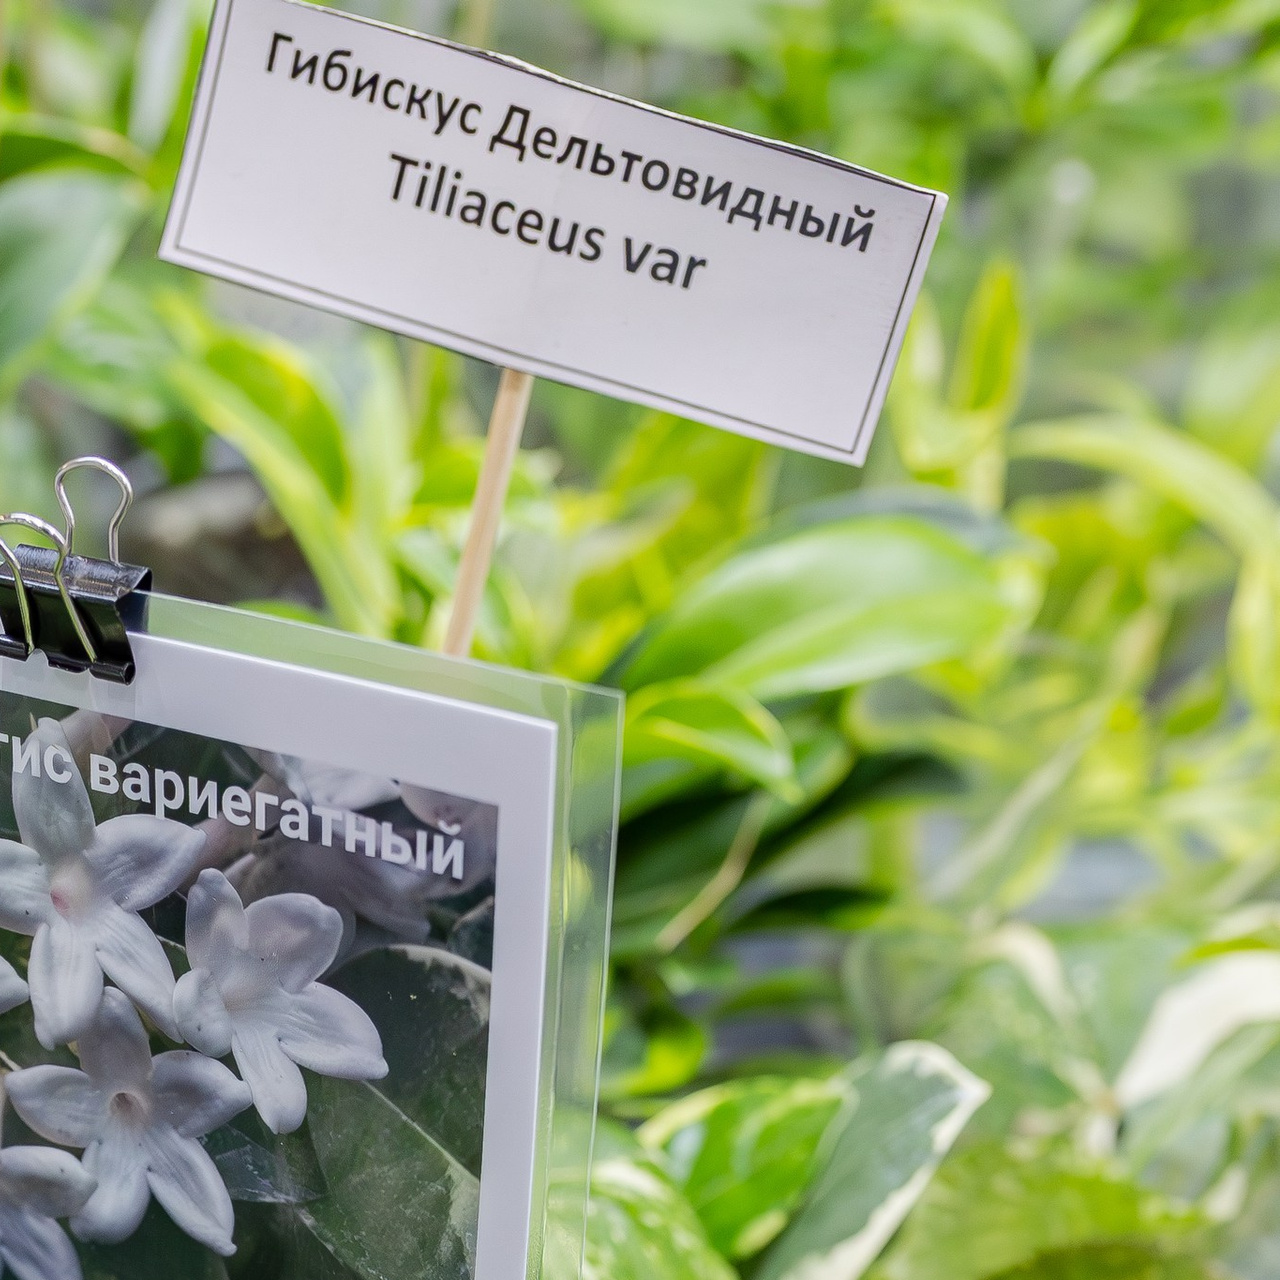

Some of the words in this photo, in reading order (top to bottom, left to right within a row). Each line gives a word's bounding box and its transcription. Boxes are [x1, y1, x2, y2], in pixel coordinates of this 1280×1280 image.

[265, 32, 483, 137] Гибискус
[488, 104, 876, 254] Дельтовидный
[389, 153, 606, 263] Tiliaceus
[622, 236, 709, 290] var
[89, 752, 467, 881] вариегатный
